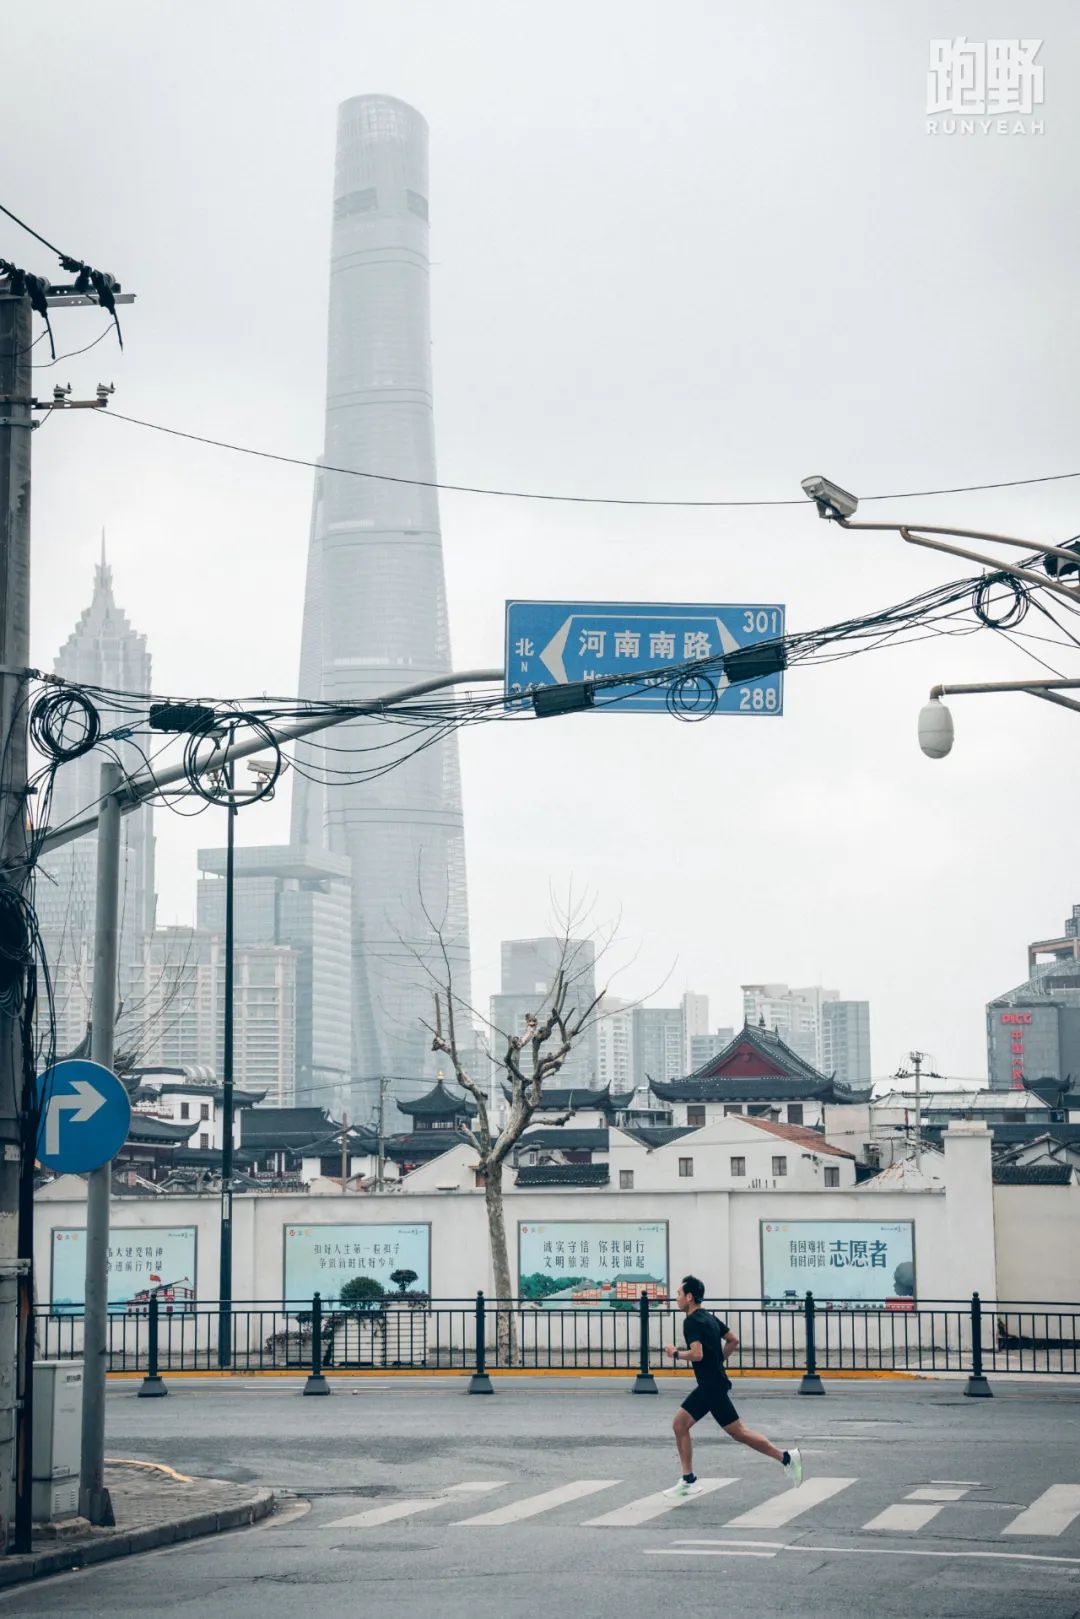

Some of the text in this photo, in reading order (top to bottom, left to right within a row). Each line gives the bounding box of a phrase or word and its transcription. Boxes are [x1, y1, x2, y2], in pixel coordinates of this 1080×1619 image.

[742, 611, 778, 633] 301
[515, 638, 534, 657] 北
[578, 629, 713, 660] 河南南路
[520, 660, 528, 673] N
[739, 687, 777, 711] 288
[1002, 1013, 1032, 1024] PICC
[543, 1240, 645, 1254] 诚实守信 你我同行
[789, 1240, 826, 1254] 有困难找
[828, 1239, 888, 1268] 志愿者
[543, 1255, 645, 1269] 文明旅游 从我做起
[789, 1254, 826, 1268] 有时间做
